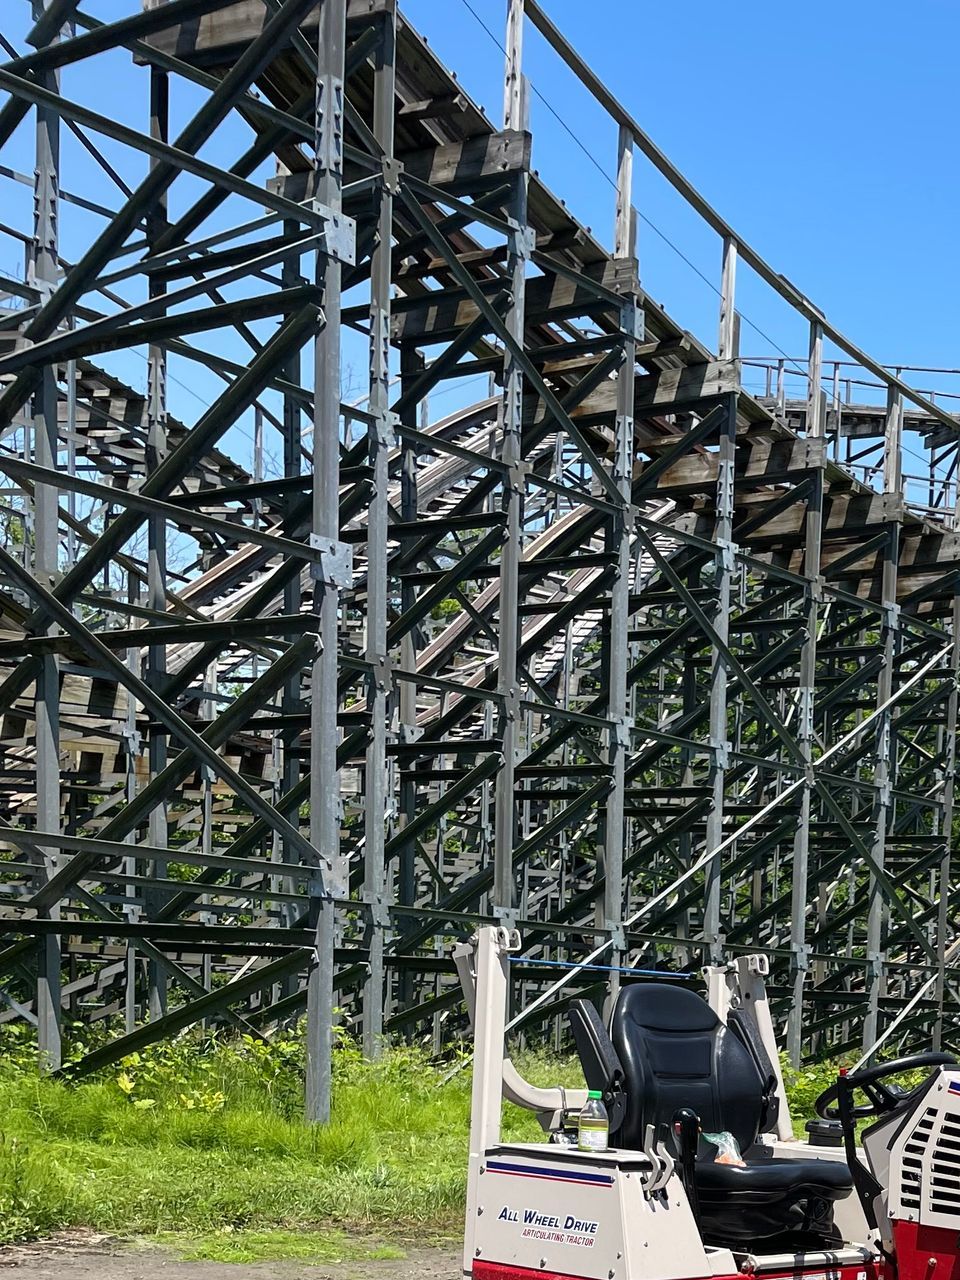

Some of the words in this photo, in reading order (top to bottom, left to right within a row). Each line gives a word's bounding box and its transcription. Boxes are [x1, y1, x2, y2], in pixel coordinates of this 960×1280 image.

[498, 1206, 519, 1222] ALL
[523, 1209, 560, 1228] WHEEL
[563, 1215, 598, 1234] DRIVE
[522, 1228, 564, 1243] ARTICULATING
[566, 1234, 595, 1247] TRACTOR
